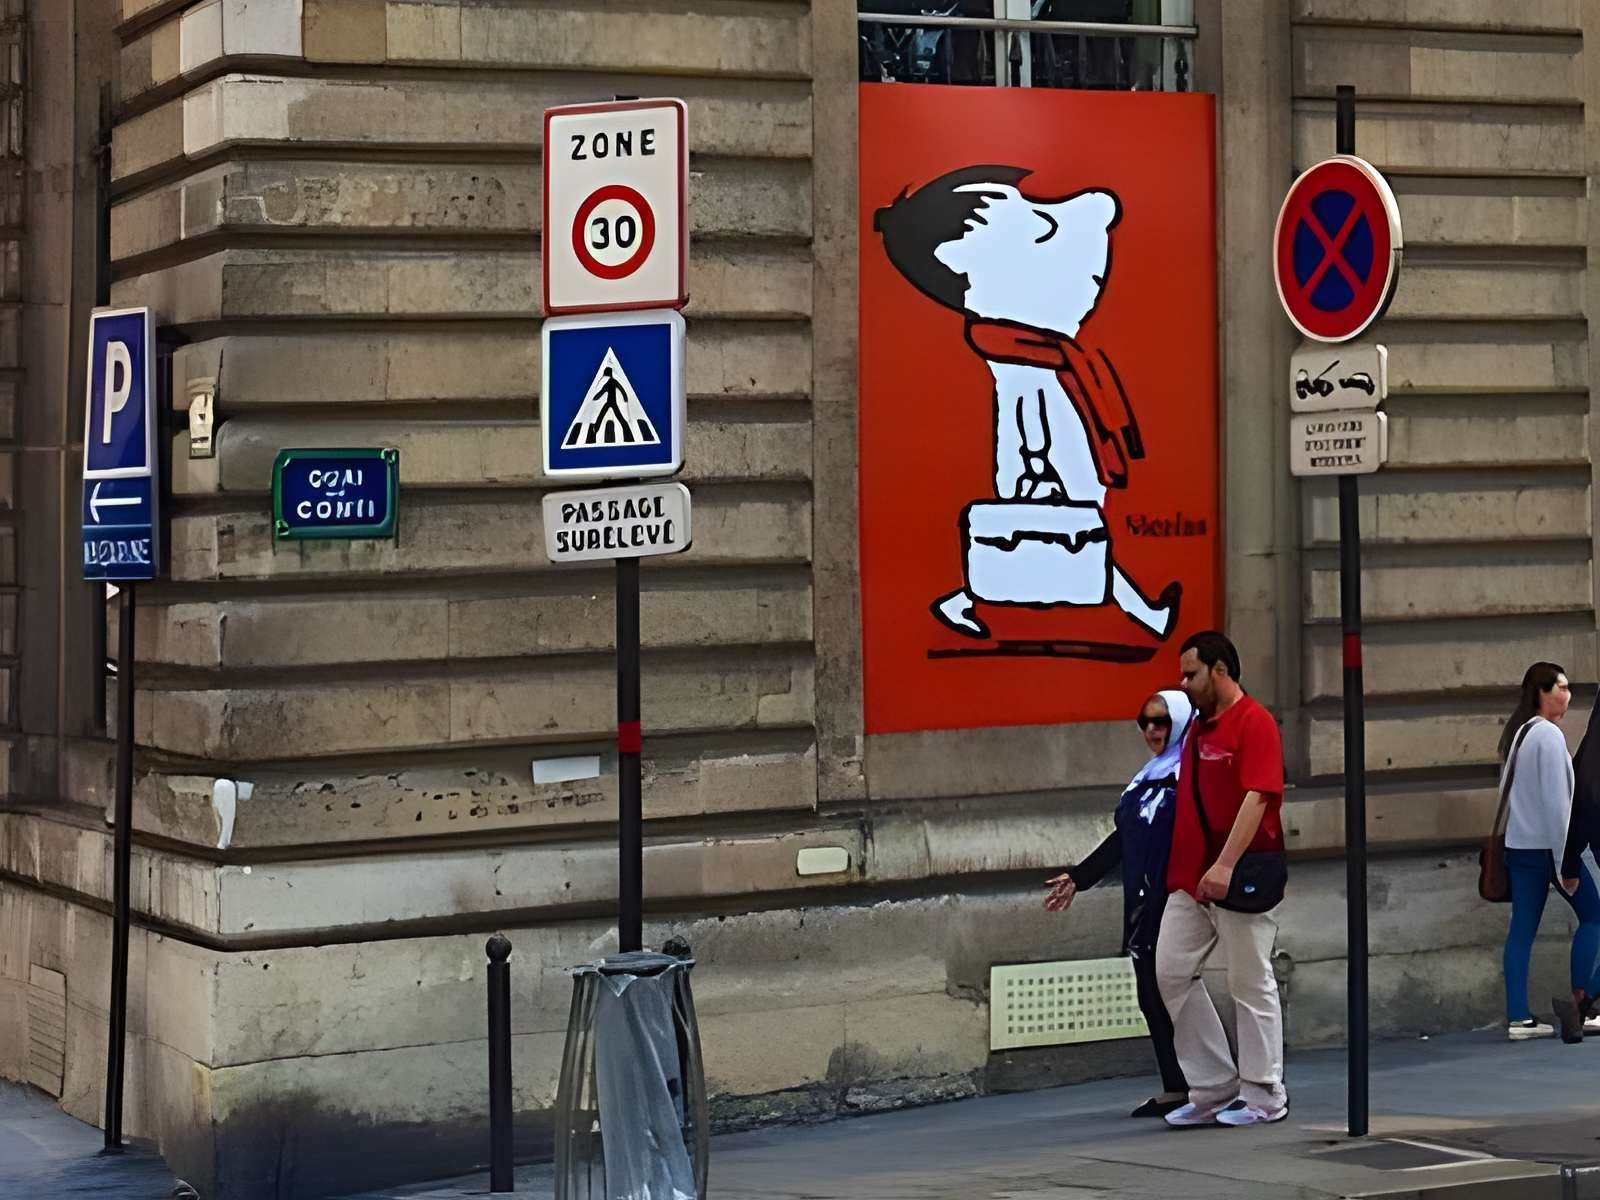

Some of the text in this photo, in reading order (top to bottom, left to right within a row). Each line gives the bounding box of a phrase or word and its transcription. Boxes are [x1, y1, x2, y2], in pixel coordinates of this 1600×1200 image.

[570, 128, 656, 162] ZONE
[590, 215, 637, 250] 30
[103, 341, 132, 444] P
